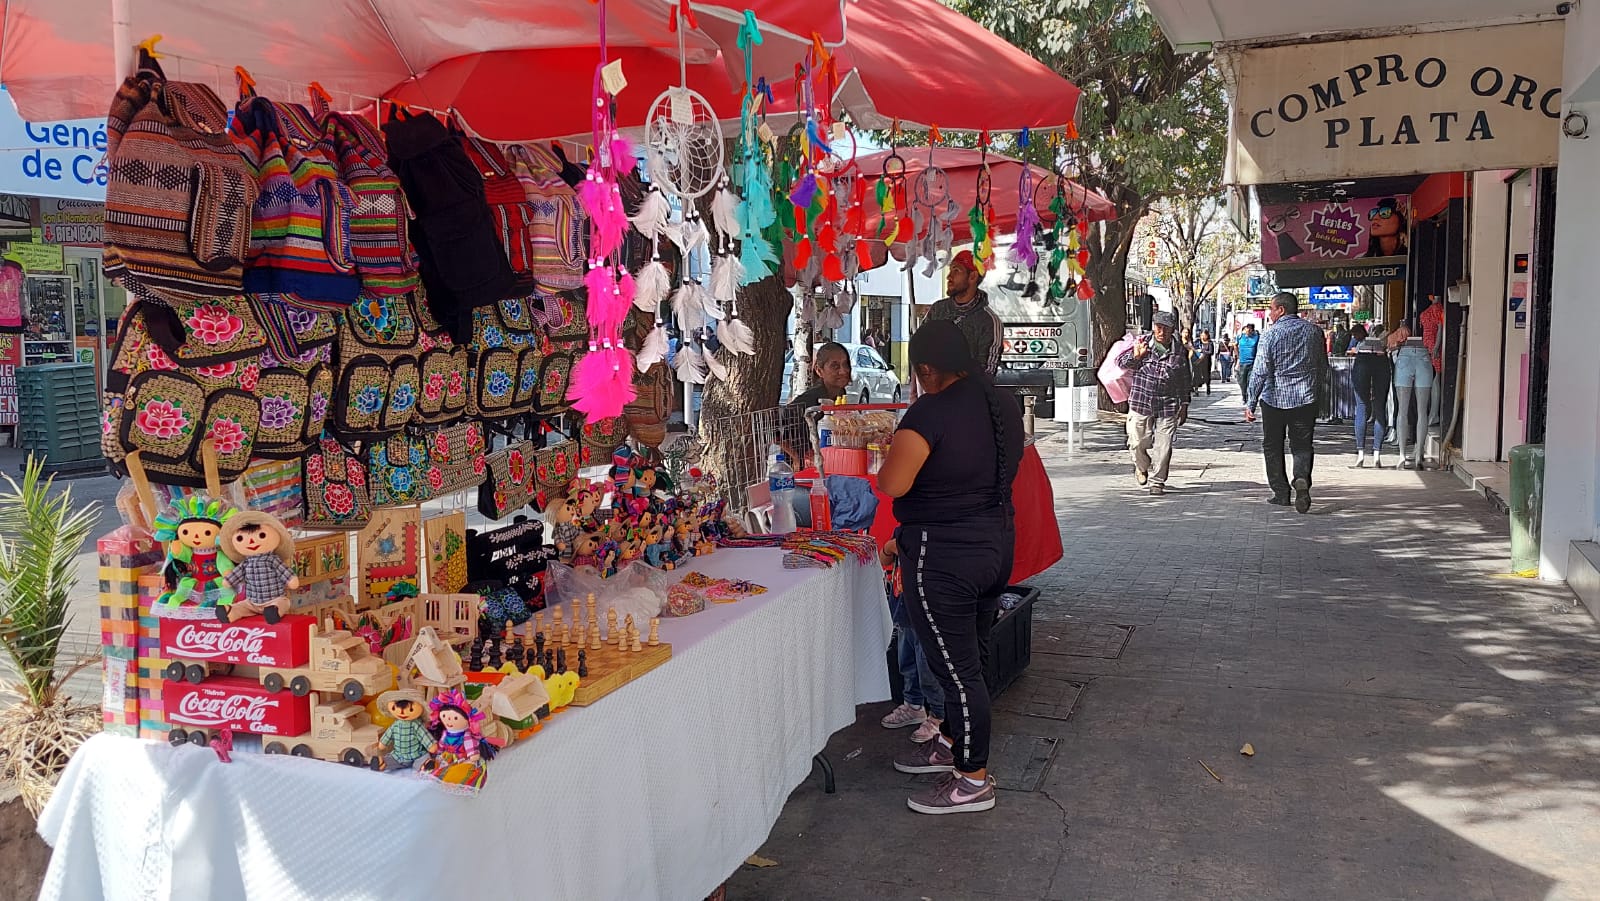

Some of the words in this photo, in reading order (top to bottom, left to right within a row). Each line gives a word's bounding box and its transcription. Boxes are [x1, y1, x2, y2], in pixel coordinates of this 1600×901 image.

[1250, 54, 1447, 138] COMPRO
[1470, 66, 1562, 119] ORO
[1324, 110, 1495, 149] PLATA
[22, 149, 62, 180] de
[1320, 215, 1353, 231] Lentes
[55, 225, 78, 242] BIEN
[1345, 267, 1400, 278] movistar
[1028, 328, 1063, 337] CENTRO
[175, 624, 277, 653] Coca-Cola
[246, 652, 276, 665] Coke
[179, 691, 279, 722] Coca-Cola
[249, 721, 278, 733] Coke
